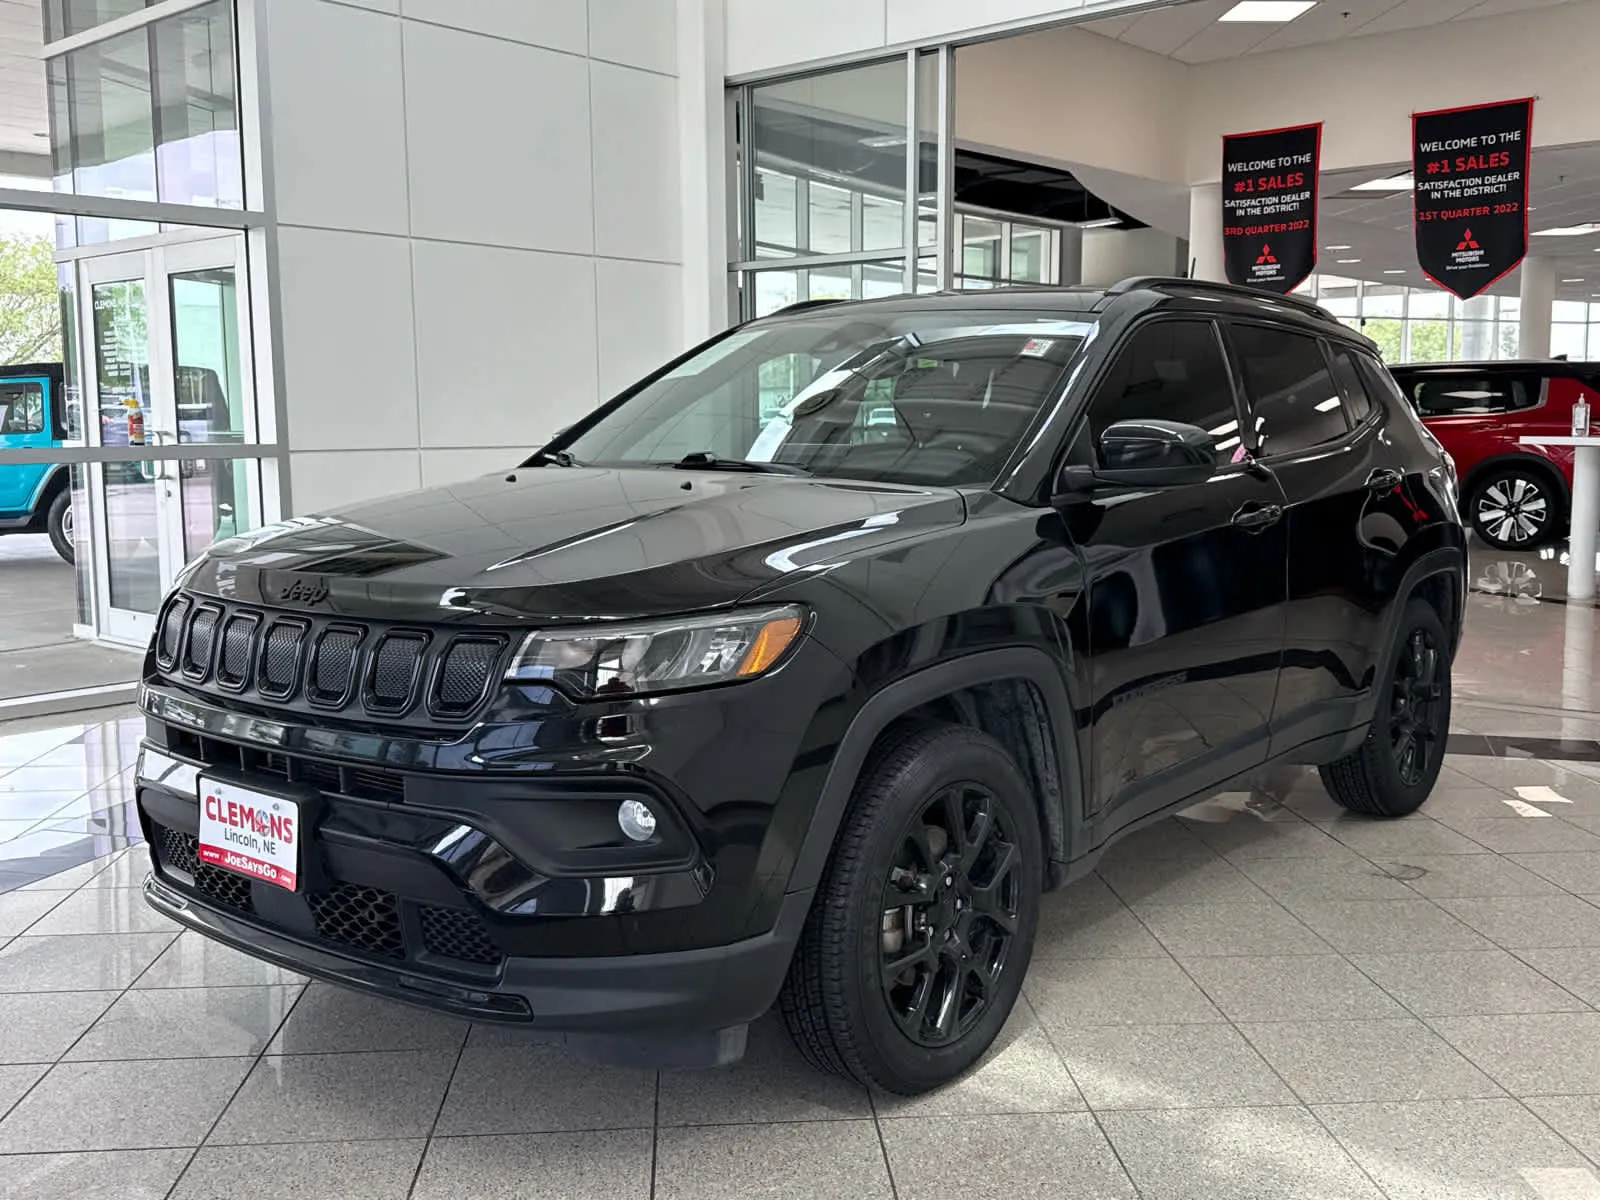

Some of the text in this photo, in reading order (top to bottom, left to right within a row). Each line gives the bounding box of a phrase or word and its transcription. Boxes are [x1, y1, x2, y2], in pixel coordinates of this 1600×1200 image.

[1420, 130, 1521, 153] WELCOME TO THE
[1227, 153, 1312, 173] WELCOME TO THE
[1425, 151, 1510, 175] #1 SALES
[1233, 172, 1304, 193] #1 SALES
[1418, 171, 1520, 191] SATISFACTION DEALER
[1224, 191, 1311, 208] SATISFACTION DEALER
[1431, 184, 1507, 199] IN THE DISTRICT!
[1236, 202, 1300, 216] IN THE DISTRICT!
[1419, 202, 1519, 221] 1ST QUARTER 2022
[1223, 219, 1309, 236] 3RD QUARTER 2022
[281, 579, 329, 606] Jeep
[224, 828, 277, 855] Lincoln, NE
